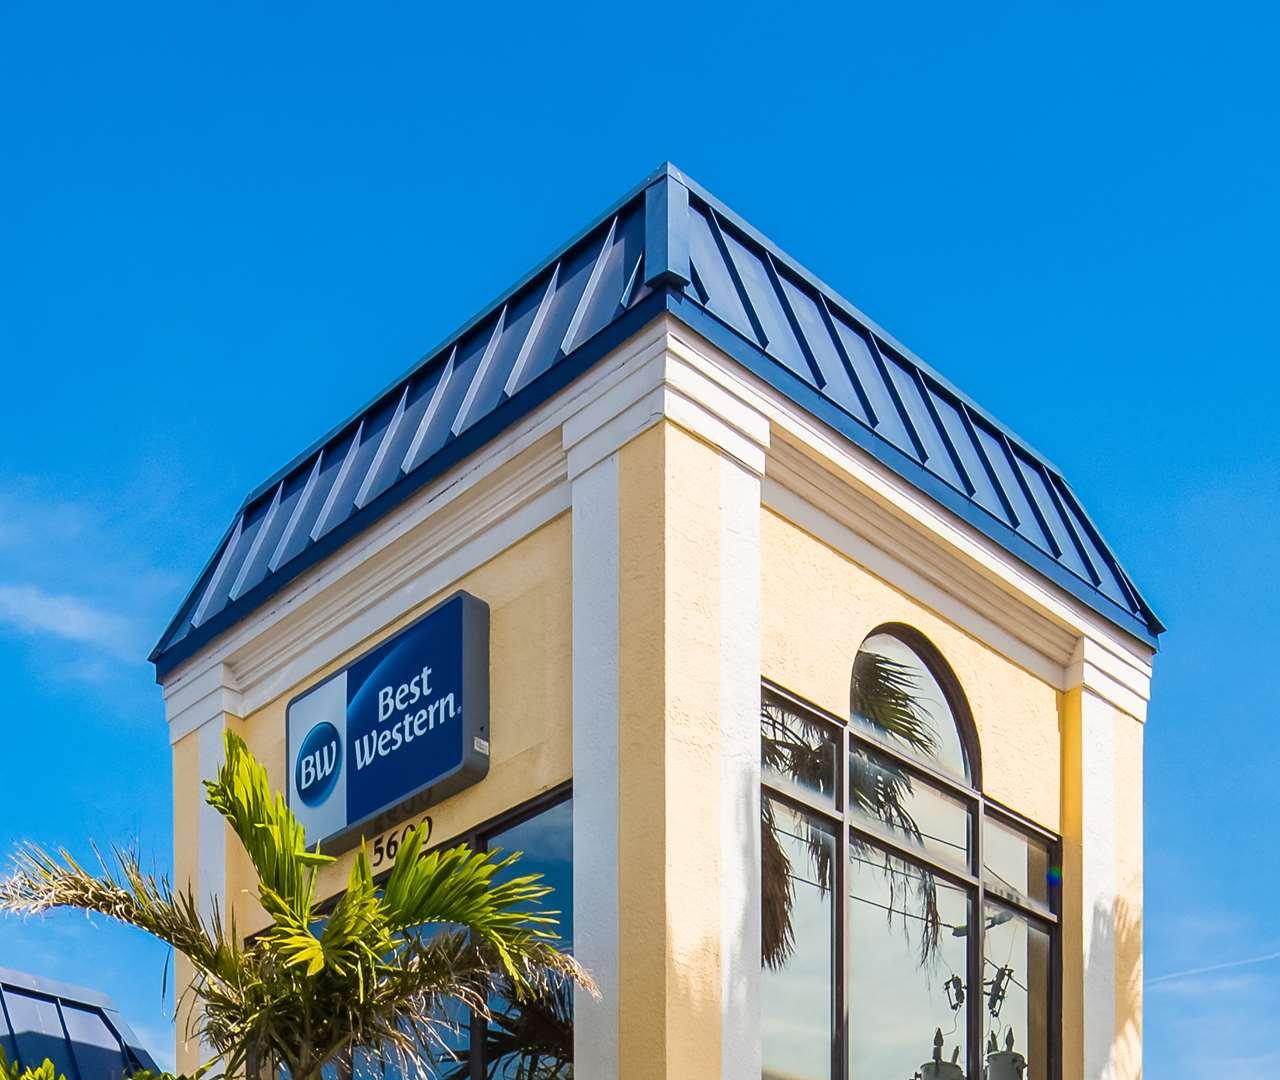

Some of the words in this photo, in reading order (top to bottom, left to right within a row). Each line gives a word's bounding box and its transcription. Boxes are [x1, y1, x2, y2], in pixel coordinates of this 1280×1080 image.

[378, 665, 432, 723] Best
[354, 692, 457, 771] Western
[300, 741, 336, 790] BW
